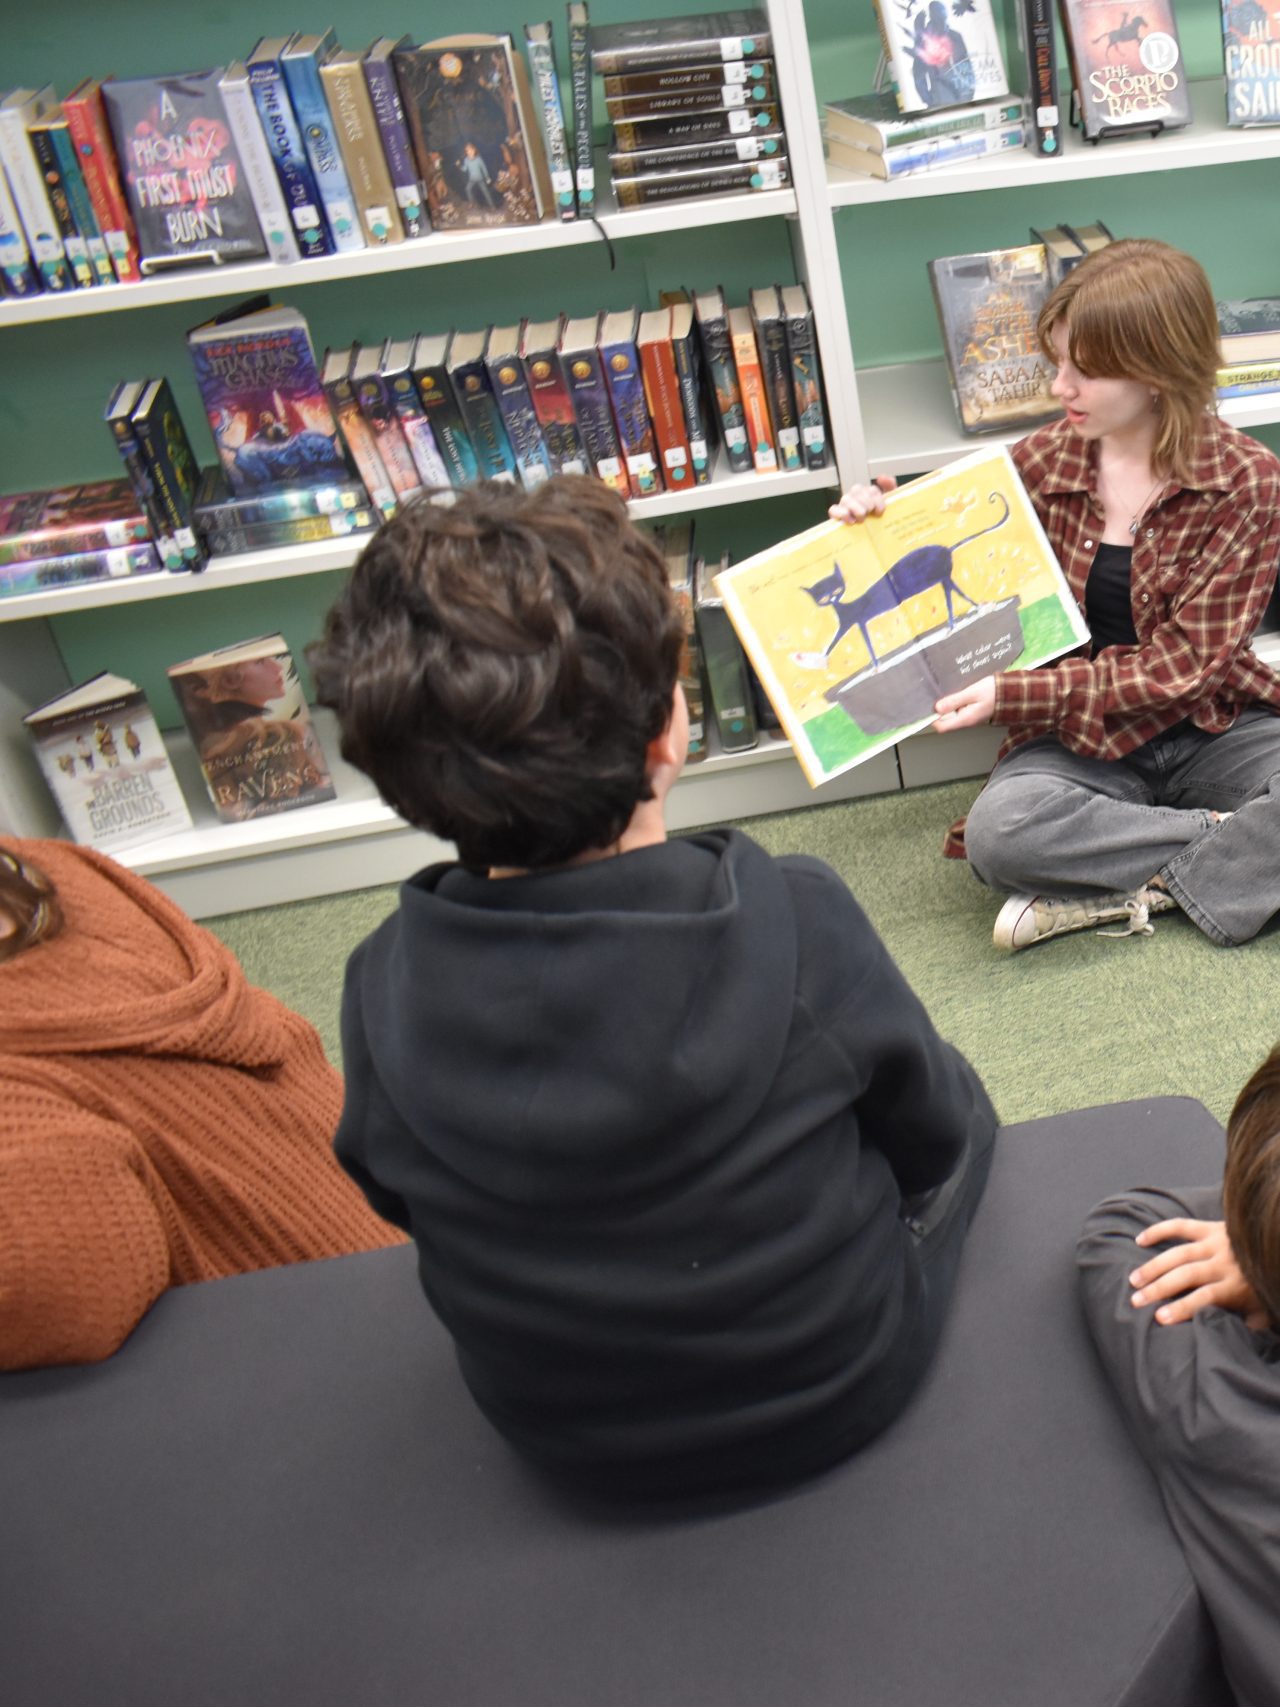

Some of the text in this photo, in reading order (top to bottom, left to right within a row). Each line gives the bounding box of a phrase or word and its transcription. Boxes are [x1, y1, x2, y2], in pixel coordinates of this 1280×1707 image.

[1248, 20, 1271, 41] ALL
[660, 73, 711, 86] HOLLOW CITY
[1089, 71, 1178, 103] SCORPIO
[1102, 64, 1130, 79] THE
[161, 90, 177, 122] A
[262, 82, 280, 112] THE
[574, 71, 587, 111] TALES
[650, 98, 681, 109] LIBRARY
[1108, 94, 1172, 119] RACES
[132, 128, 221, 167] PHOENIX
[270, 114, 293, 158] BOOK
[136, 164, 234, 208] FIRST MUST
[166, 207, 223, 245] BURN
[977, 361, 1047, 388] SABAA
[1227, 370, 1275, 383] STRANGE
[988, 383, 1042, 403] TAHIR
[974, 643, 991, 655] color
[92, 773, 154, 807] BARREN
[217, 764, 321, 806] RAVENS
[90, 791, 165, 832] GROUNDS
